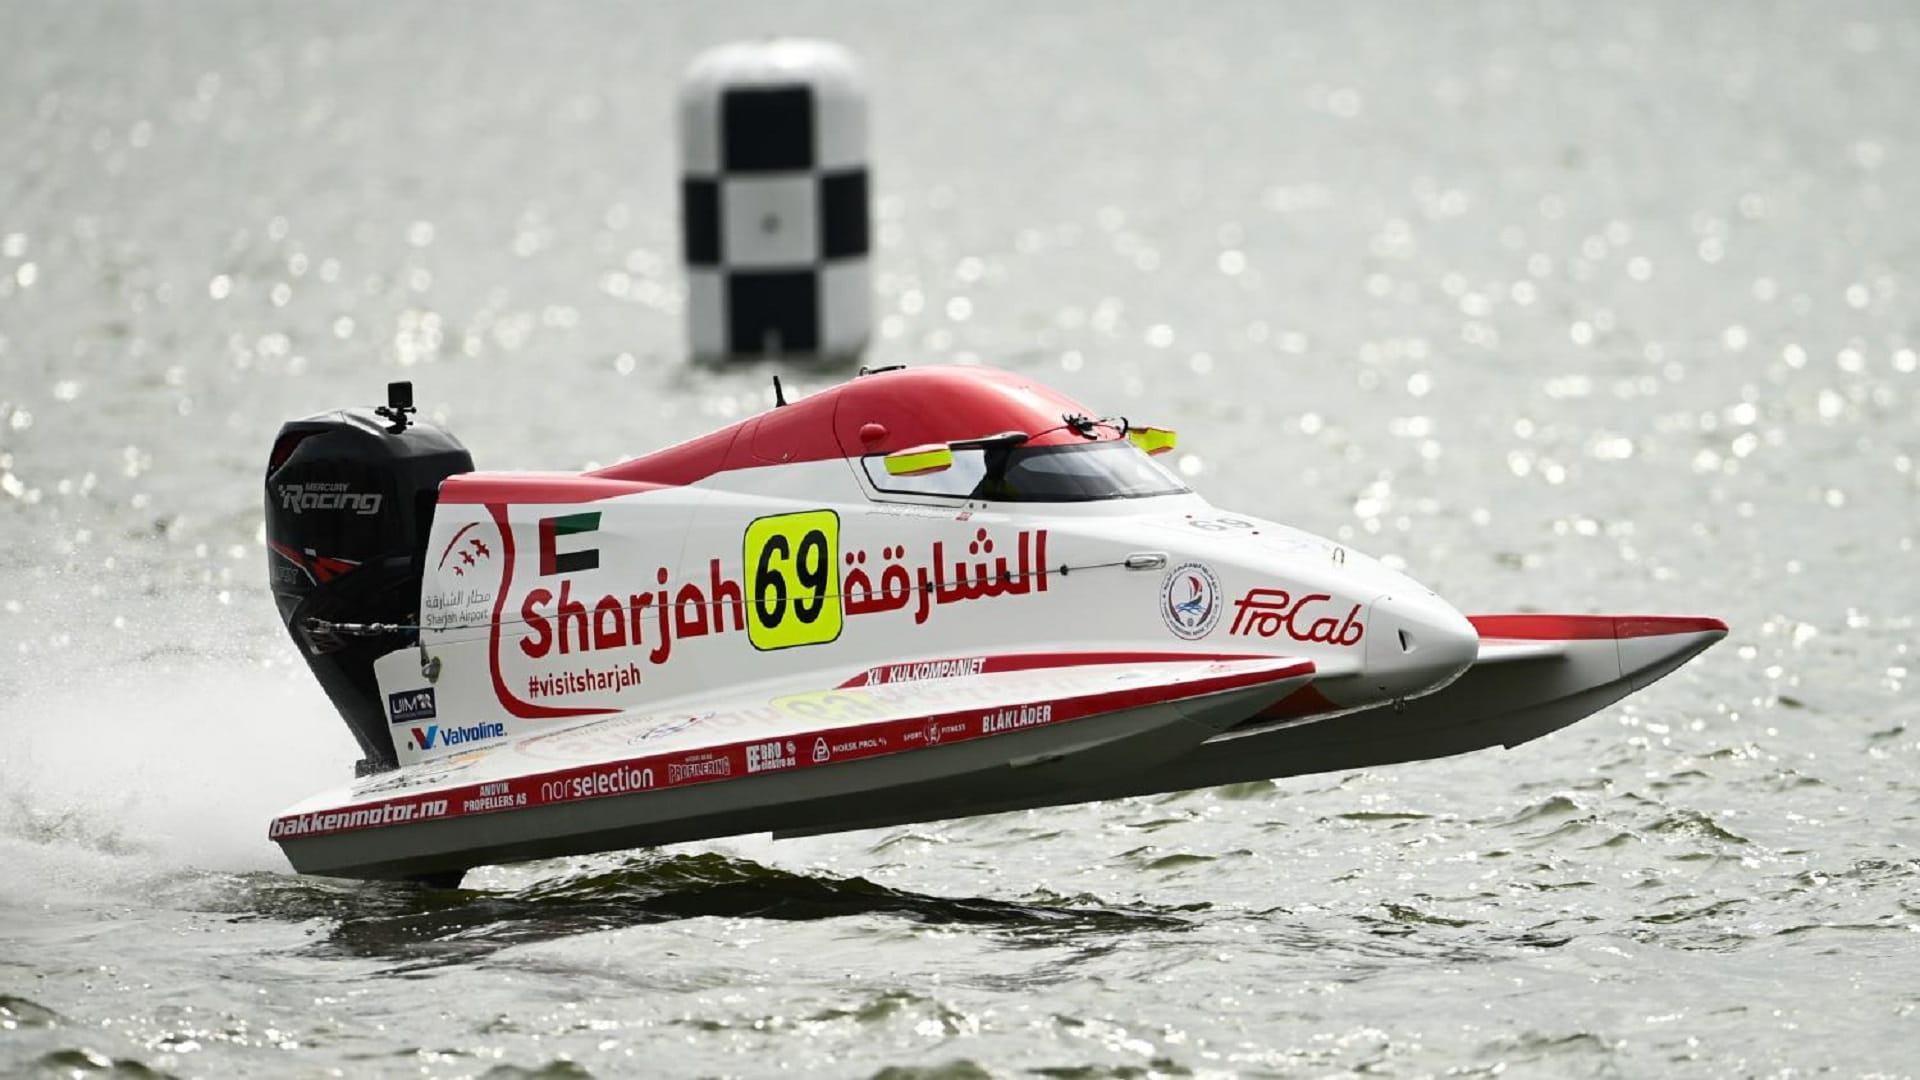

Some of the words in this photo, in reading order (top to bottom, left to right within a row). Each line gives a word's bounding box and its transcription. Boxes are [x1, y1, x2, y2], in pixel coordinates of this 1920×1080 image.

[281, 484, 382, 515] Racing
[304, 482, 350, 492] MERCURY
[754, 529, 829, 629] 69
[843, 527, 1048, 625] الشارقة
[426, 613, 458, 626] Sharjah
[460, 609, 489, 623] Airport
[519, 558, 745, 664] Sharjah
[1229, 588, 1364, 646] ProCab
[528, 663, 641, 698] #visitsharjah
[887, 657, 986, 683] KULKOMPANIET
[982, 704, 1052, 733] BLÅKLÄDER
[464, 795, 514, 812] PROPELLERS
[515, 792, 527, 806] AS
[480, 782, 509, 796] ANDVIK
[270, 799, 448, 837] bakkenmotor.no
